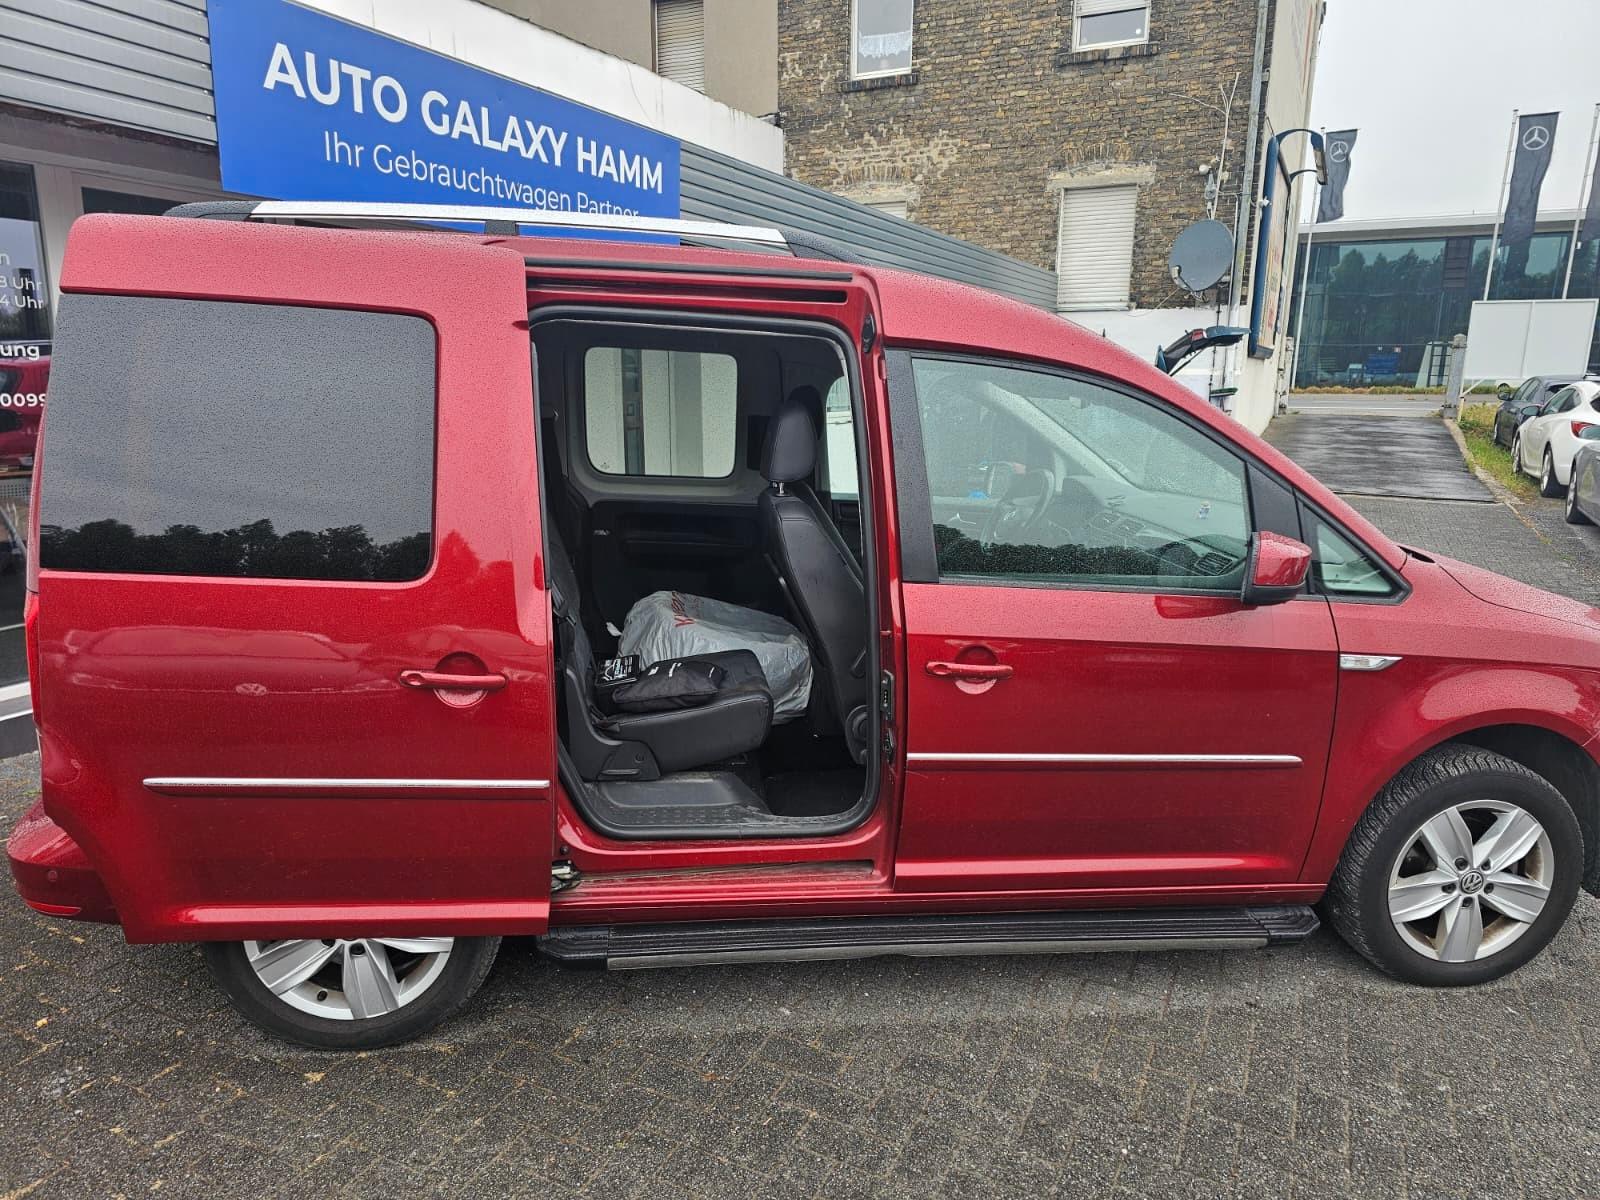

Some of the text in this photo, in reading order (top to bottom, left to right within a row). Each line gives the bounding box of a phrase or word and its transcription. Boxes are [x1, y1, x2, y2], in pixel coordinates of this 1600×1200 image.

[263, 42, 663, 194] AUTO GALAXY HAMM
[323, 130, 364, 168] Ihr
[372, 143, 571, 213] Gebrauchtwagen
[12, 276, 42, 291] Uhr
[14, 295, 44, 310] Uhr
[0, 344, 40, 361] ung
